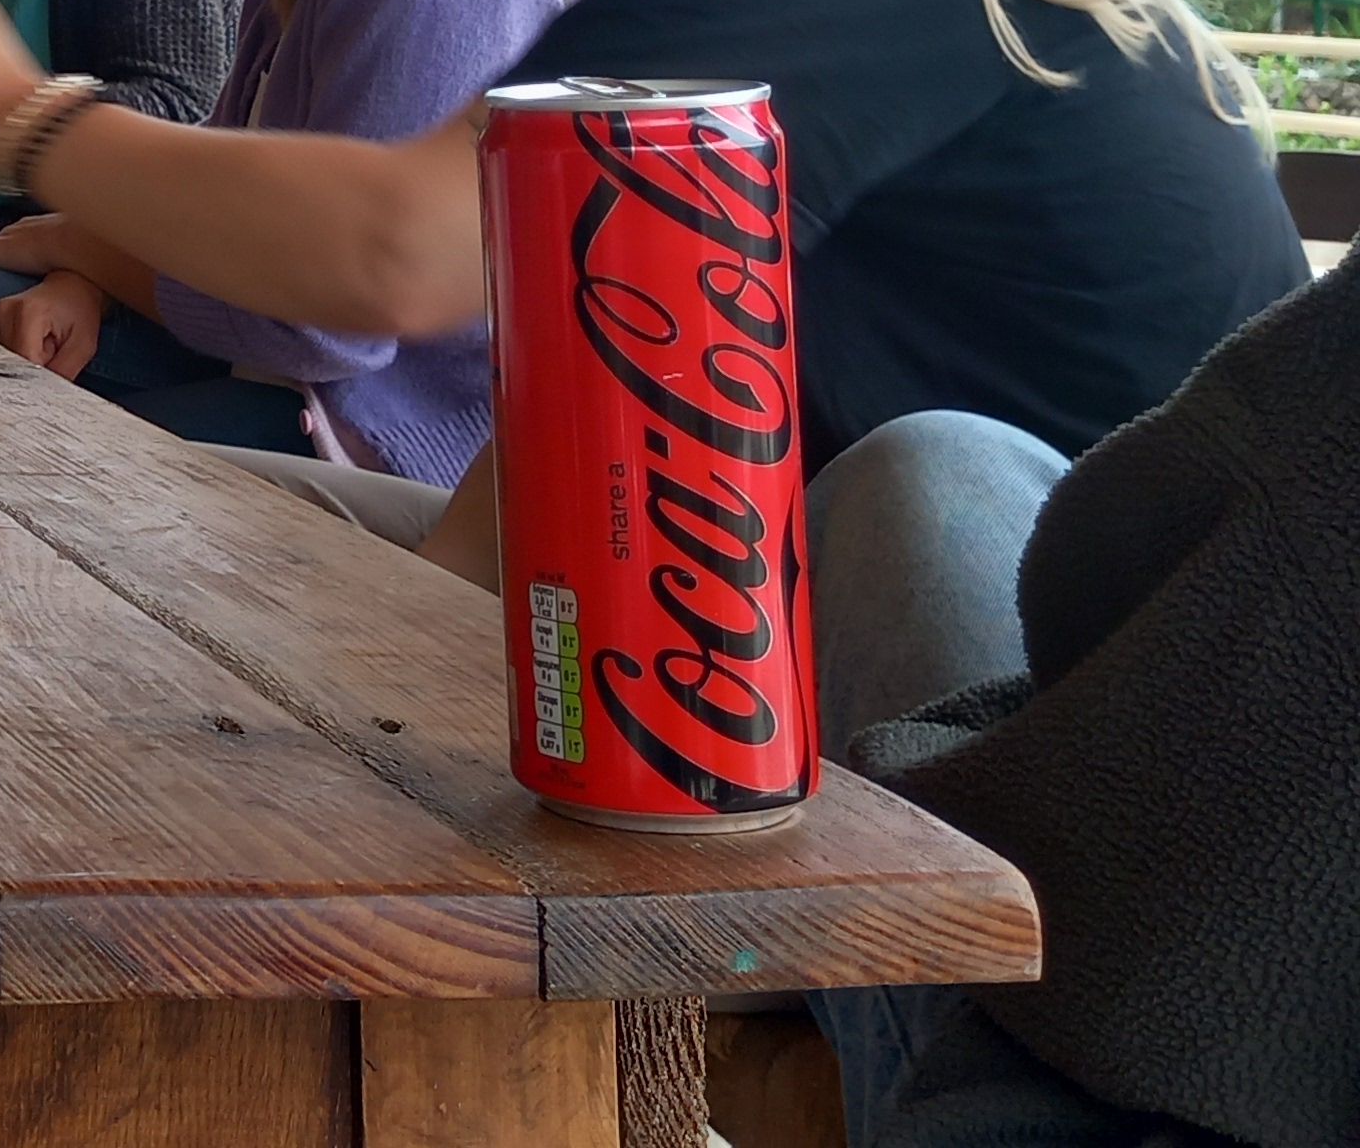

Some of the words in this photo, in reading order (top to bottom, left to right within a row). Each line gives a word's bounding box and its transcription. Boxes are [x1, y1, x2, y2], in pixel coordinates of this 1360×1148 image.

[571, 106, 810, 814] Coca-Cola
[608, 461, 625, 478] a
[607, 484, 630, 560] share
